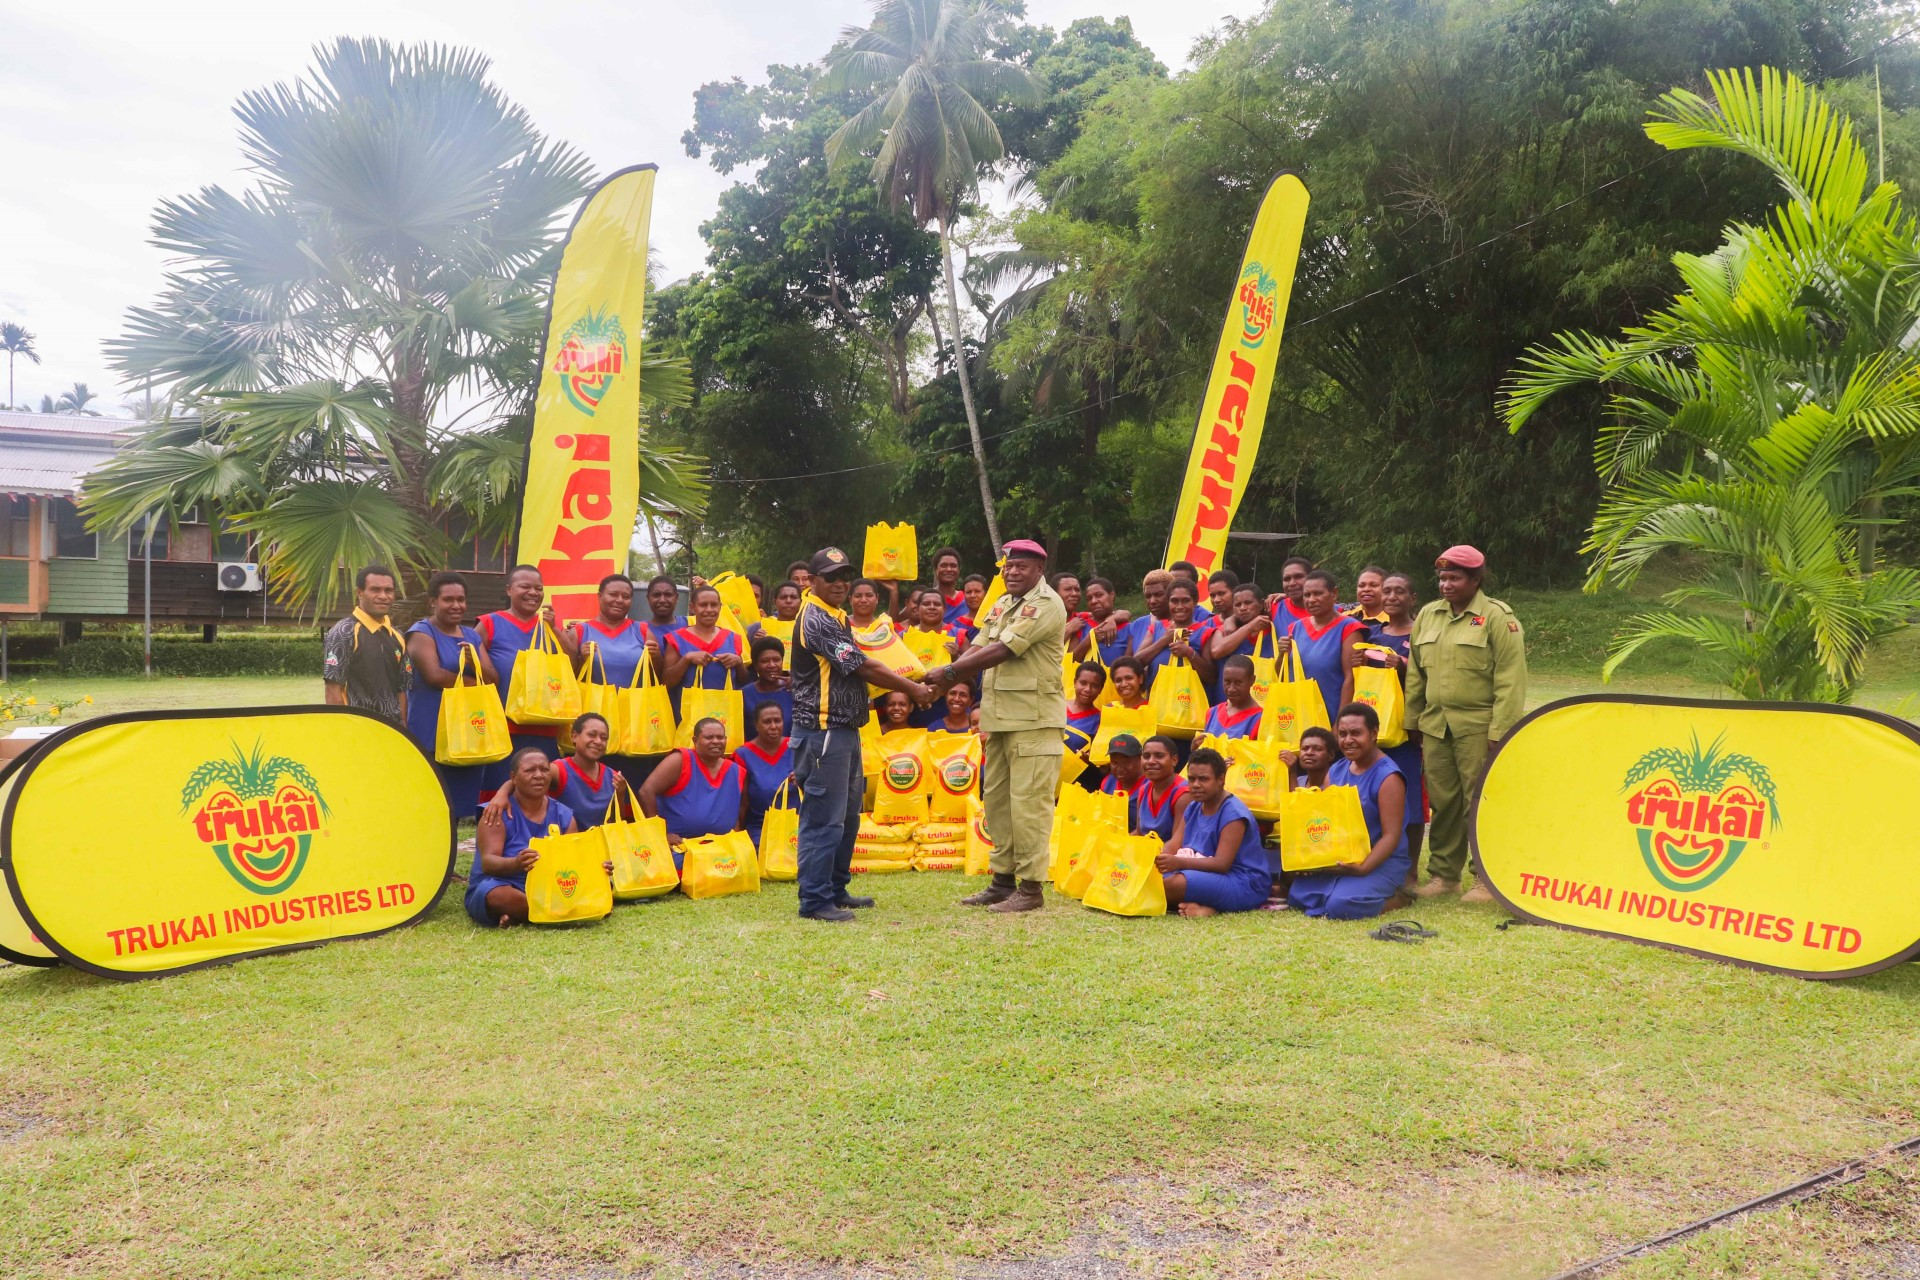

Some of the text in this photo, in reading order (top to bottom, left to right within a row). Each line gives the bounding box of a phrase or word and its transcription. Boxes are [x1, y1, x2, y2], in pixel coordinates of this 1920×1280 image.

[192, 795, 320, 843] trukai
[1626, 789, 1765, 839] trukai
[107, 883, 416, 956] TRUKAI INDUSTRIES LTD
[1519, 873, 1863, 954] TRUKAI INDUSTRIES LTD
